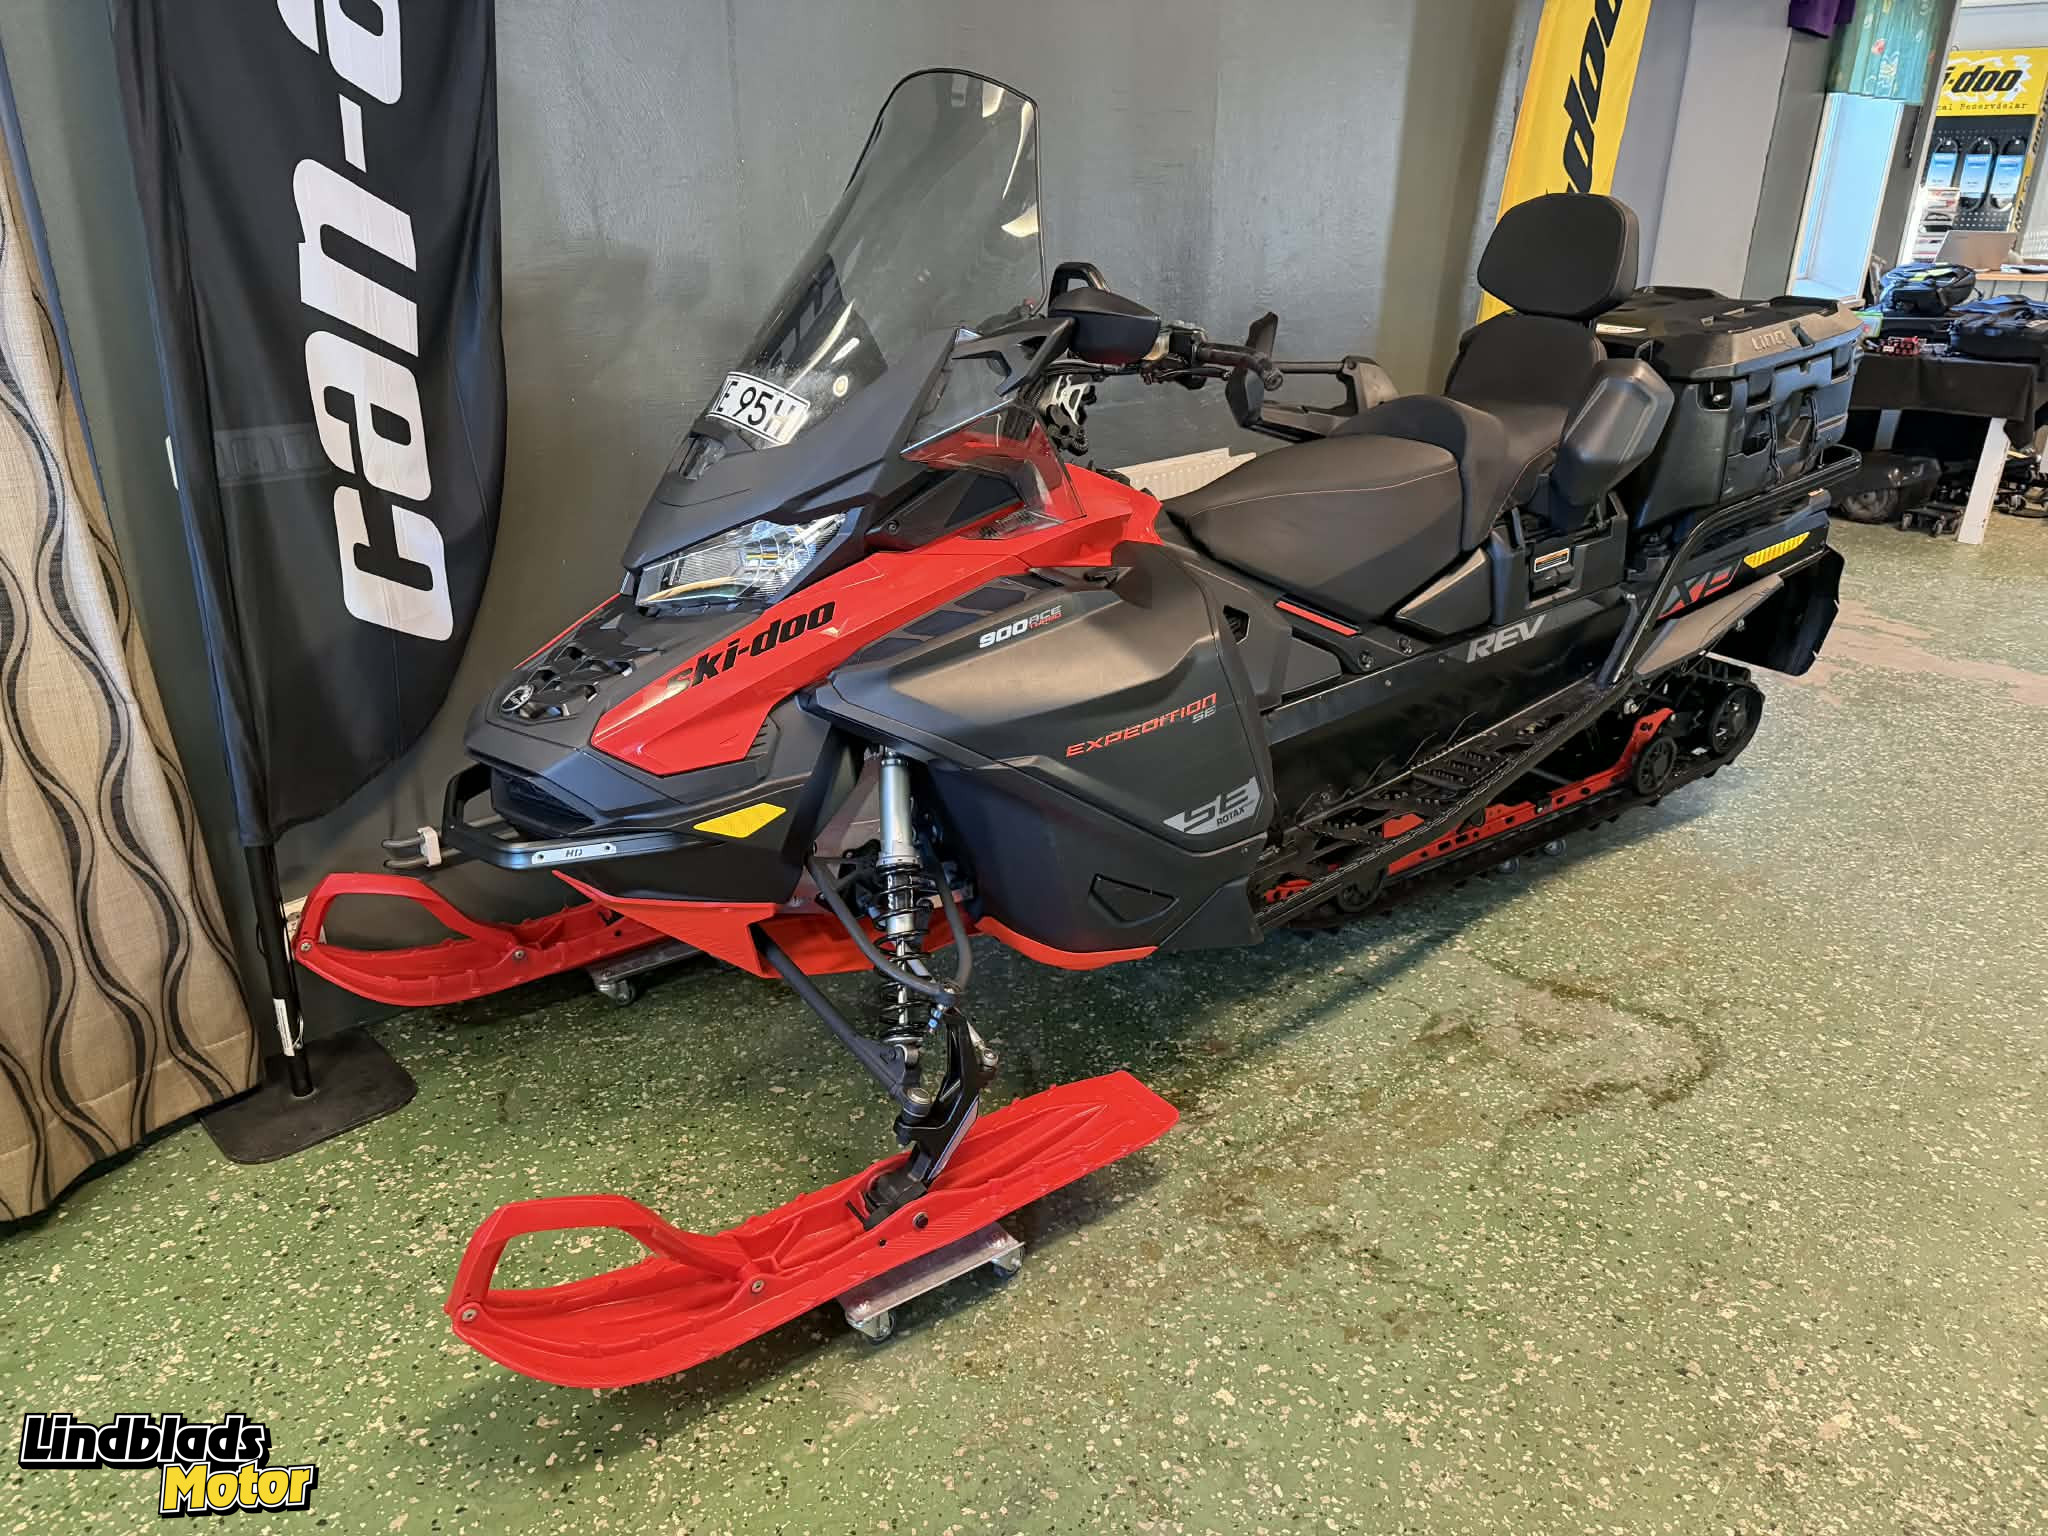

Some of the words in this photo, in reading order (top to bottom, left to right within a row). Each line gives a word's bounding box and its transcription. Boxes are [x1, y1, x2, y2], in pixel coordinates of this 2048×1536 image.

[979, 618, 1029, 648] 900
[1466, 613, 1547, 664] REV
[1217, 806, 1245, 827] ROTAX
